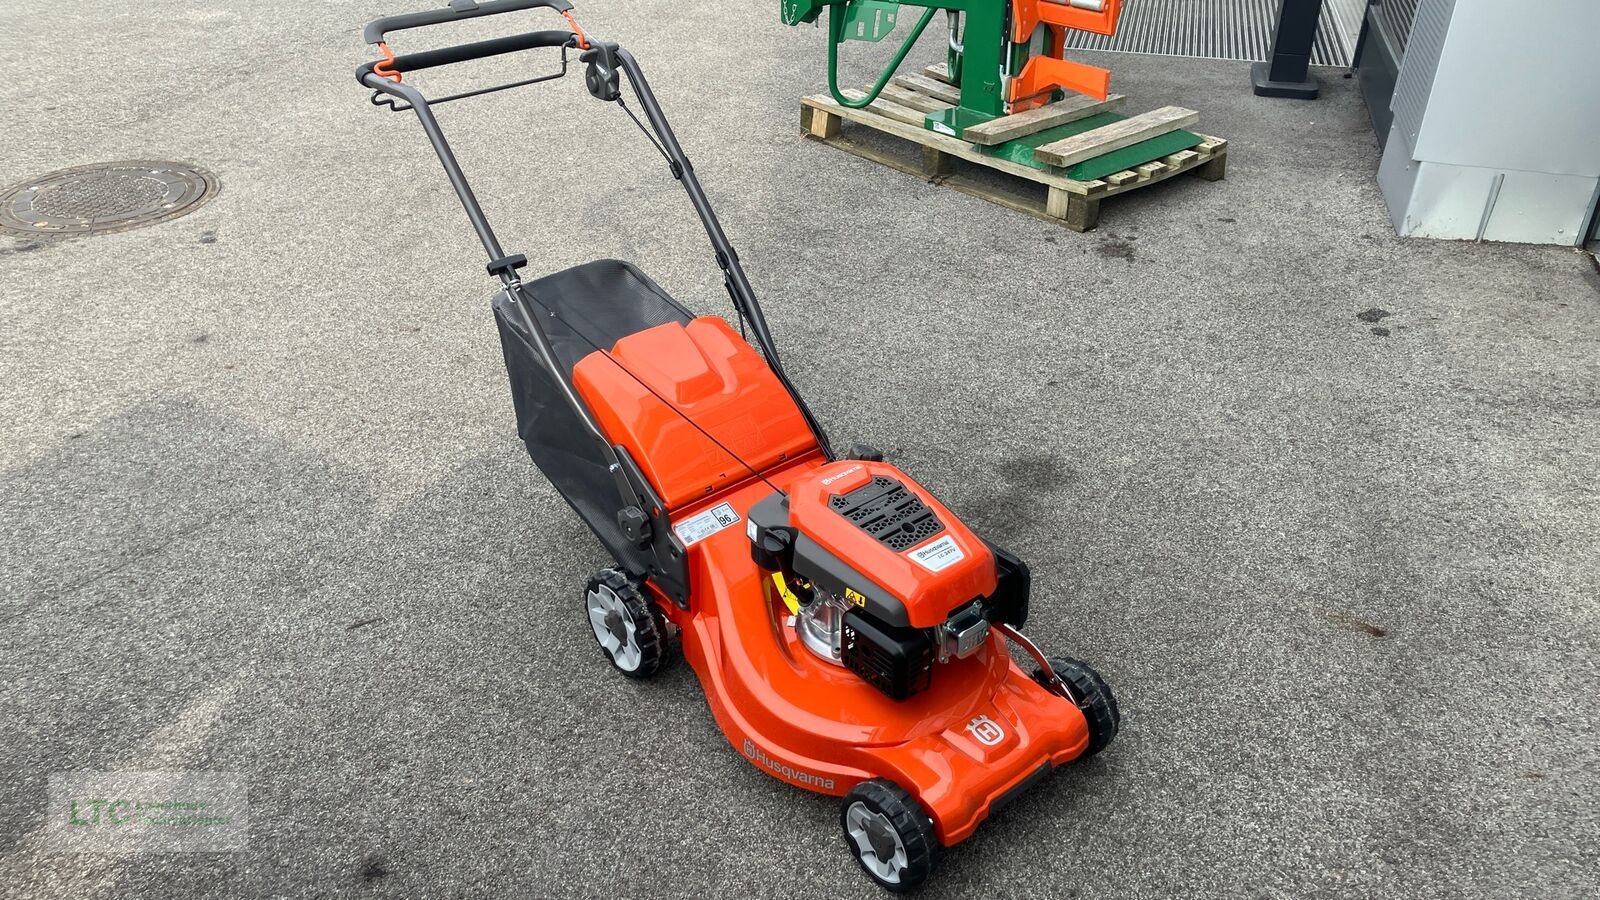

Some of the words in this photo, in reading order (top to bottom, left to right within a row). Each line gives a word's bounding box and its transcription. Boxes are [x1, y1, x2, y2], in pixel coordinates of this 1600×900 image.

[719, 514, 732, 525] 96
[922, 540, 950, 556] Husqvarna
[756, 749, 835, 790] Husqvarna
